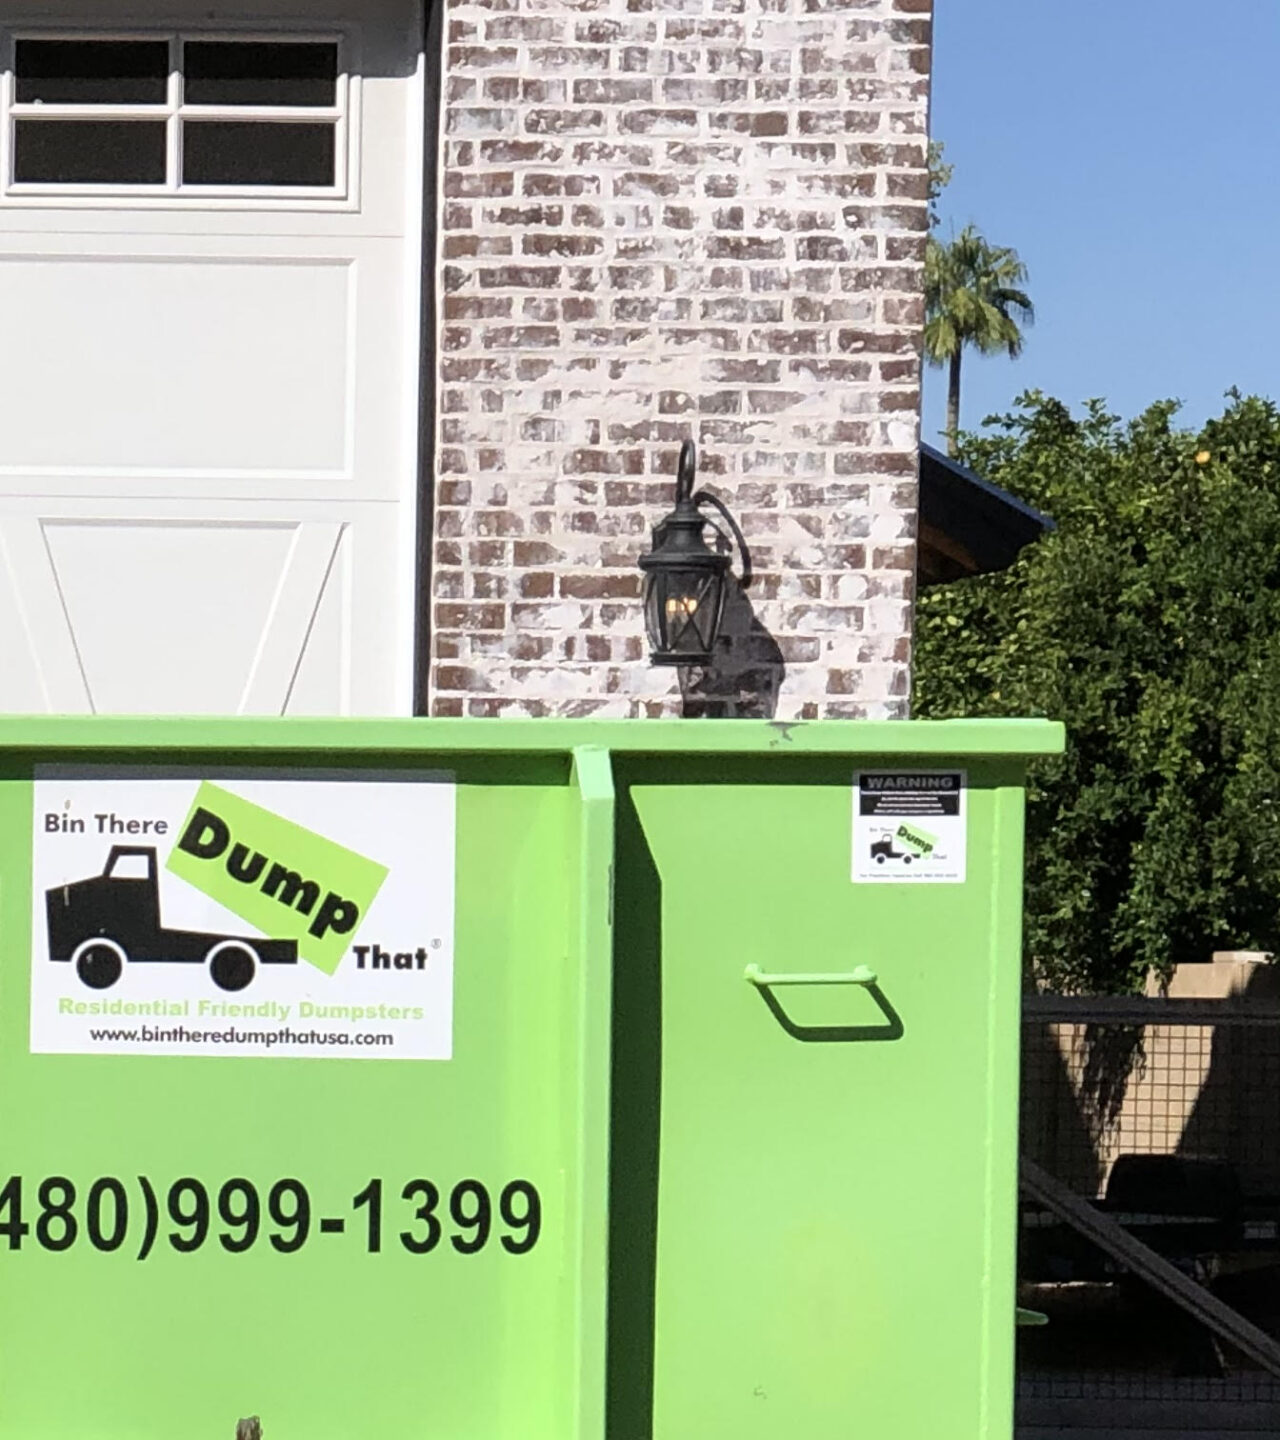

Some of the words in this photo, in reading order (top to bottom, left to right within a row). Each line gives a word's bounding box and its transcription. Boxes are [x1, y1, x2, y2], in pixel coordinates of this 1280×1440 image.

[867, 776, 953, 789] WARNING
[44, 813, 85, 834] Bin
[94, 813, 169, 836] There
[896, 825, 934, 853] Dump
[177, 806, 360, 940] Dump
[352, 944, 429, 971] That
[58, 997, 190, 1018] Residential
[198, 998, 291, 1022] Friendly
[299, 1001, 425, 1024] Dumpsters
[90, 1026, 394, 1048] www.bintheredumpthatusa.com
